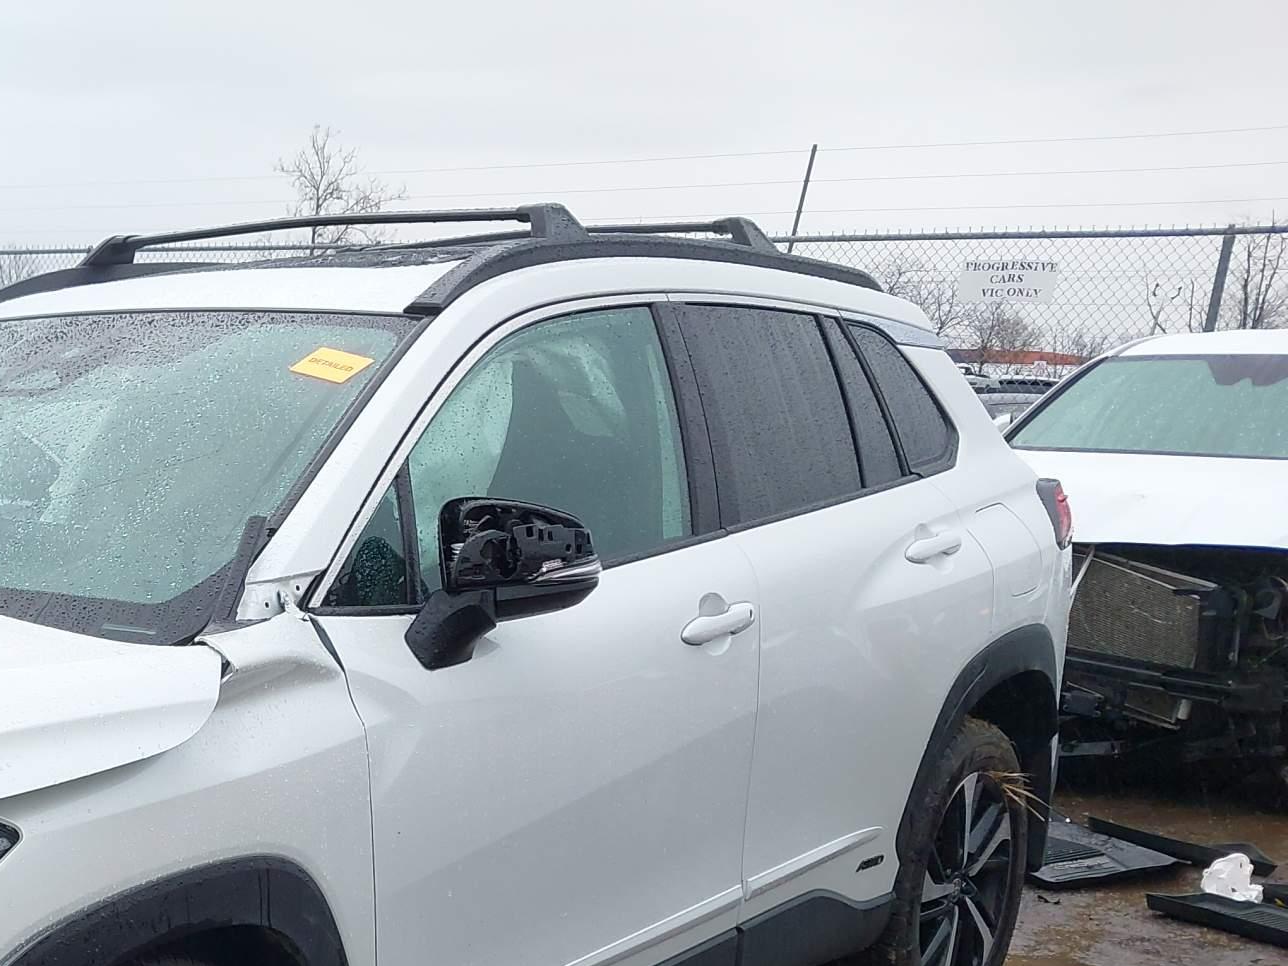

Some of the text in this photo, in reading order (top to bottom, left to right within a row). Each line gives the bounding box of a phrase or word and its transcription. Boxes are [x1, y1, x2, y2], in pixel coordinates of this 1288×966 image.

[965, 261, 1058, 272] PROGRESSIVE
[989, 274, 1025, 284] CARS
[980, 288, 1042, 298] VIC ONLY
[308, 357, 354, 373] DETAILED
